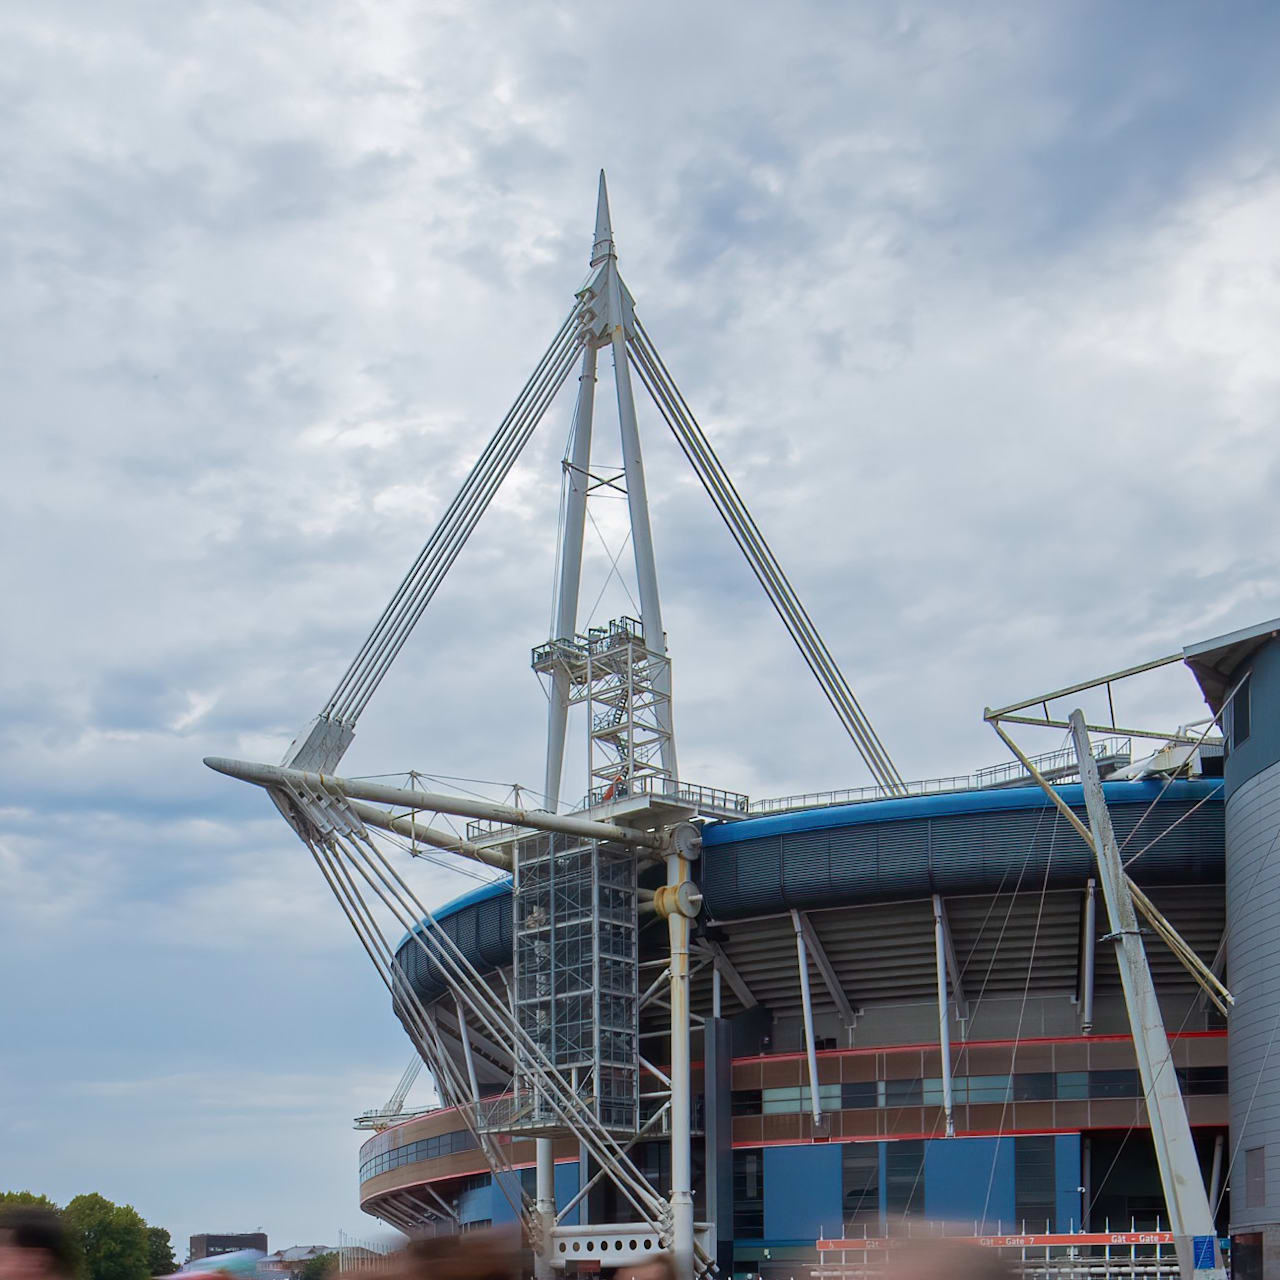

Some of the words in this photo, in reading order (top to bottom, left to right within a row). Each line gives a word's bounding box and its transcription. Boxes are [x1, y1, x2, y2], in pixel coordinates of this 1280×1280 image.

[1006, 1237, 1024, 1245] Gate
[1029, 1237, 1035, 1245] 7
[1139, 1234, 1159, 1243] Gate
[1164, 1234, 1170, 1242] 7
